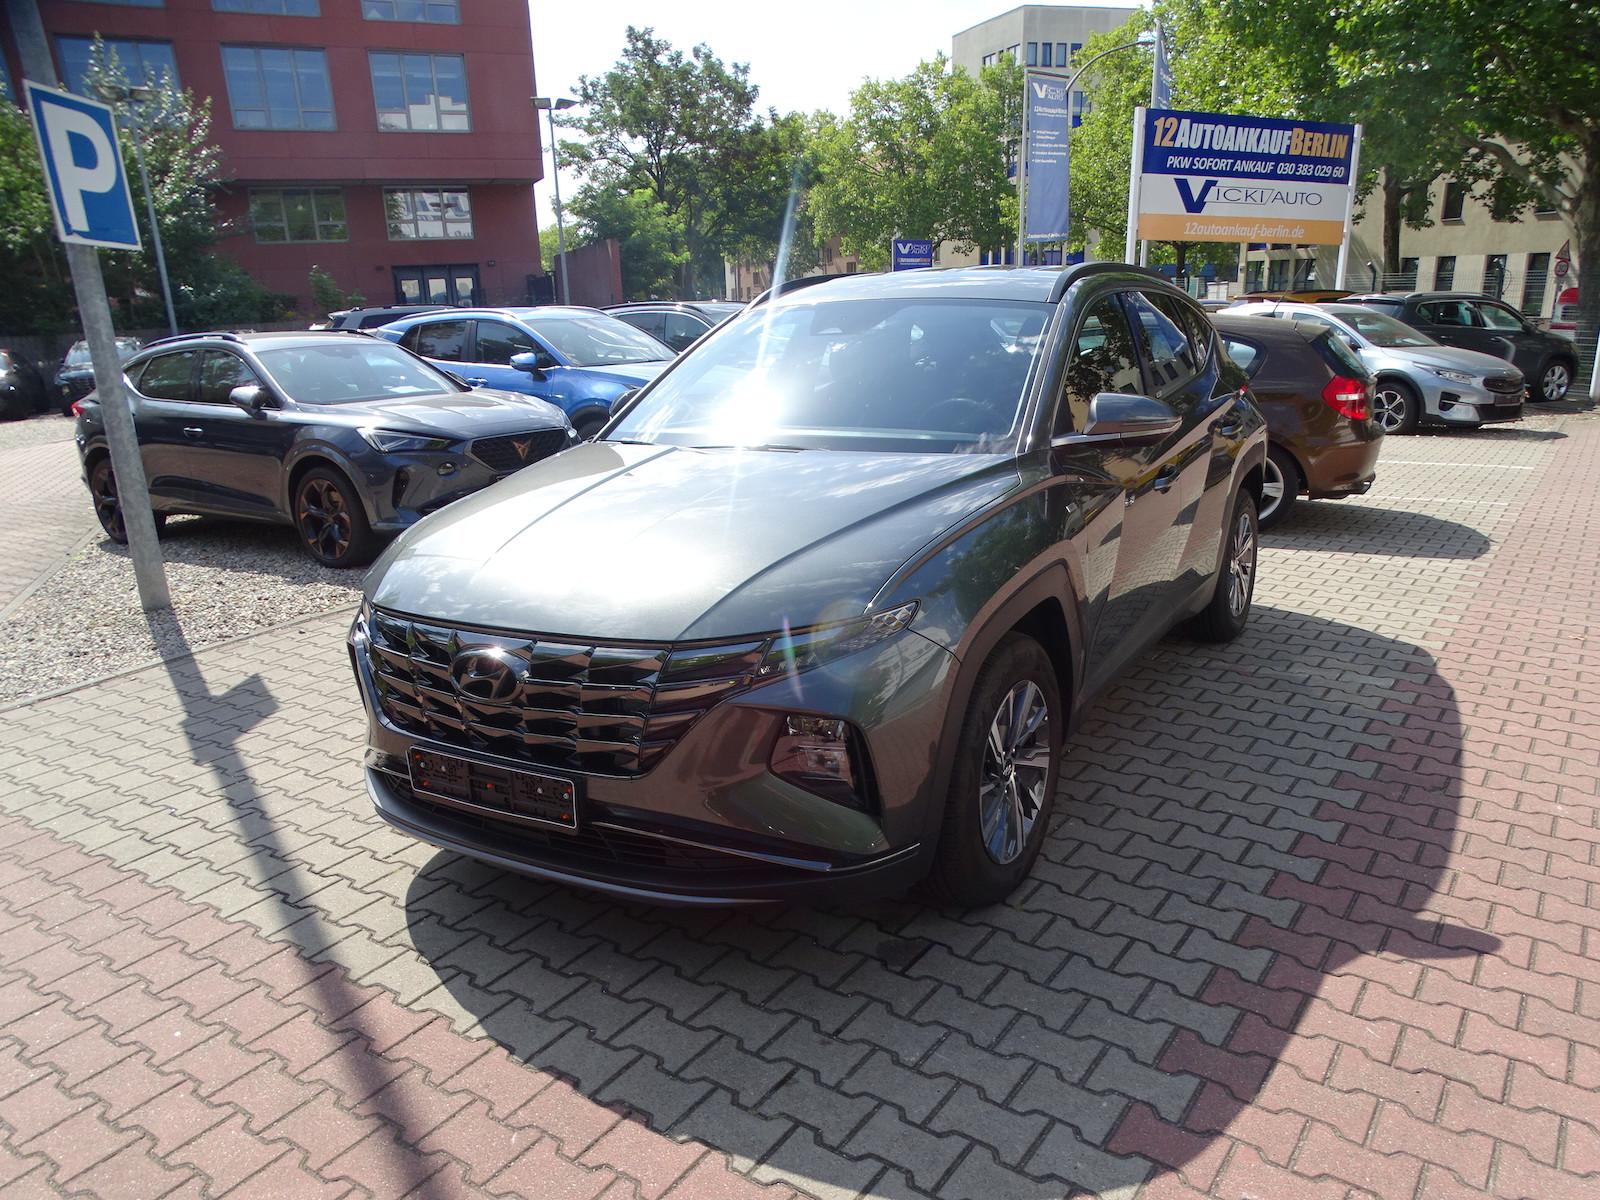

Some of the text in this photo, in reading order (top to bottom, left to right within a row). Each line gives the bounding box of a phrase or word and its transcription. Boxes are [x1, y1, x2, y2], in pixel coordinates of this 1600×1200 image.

[40, 100, 117, 232] P
[1166, 156, 1345, 178] PKW SOFORT ANKAUF 030 383 029 60
[1184, 222, 1304, 239] 12autoankauf-berlin.de
